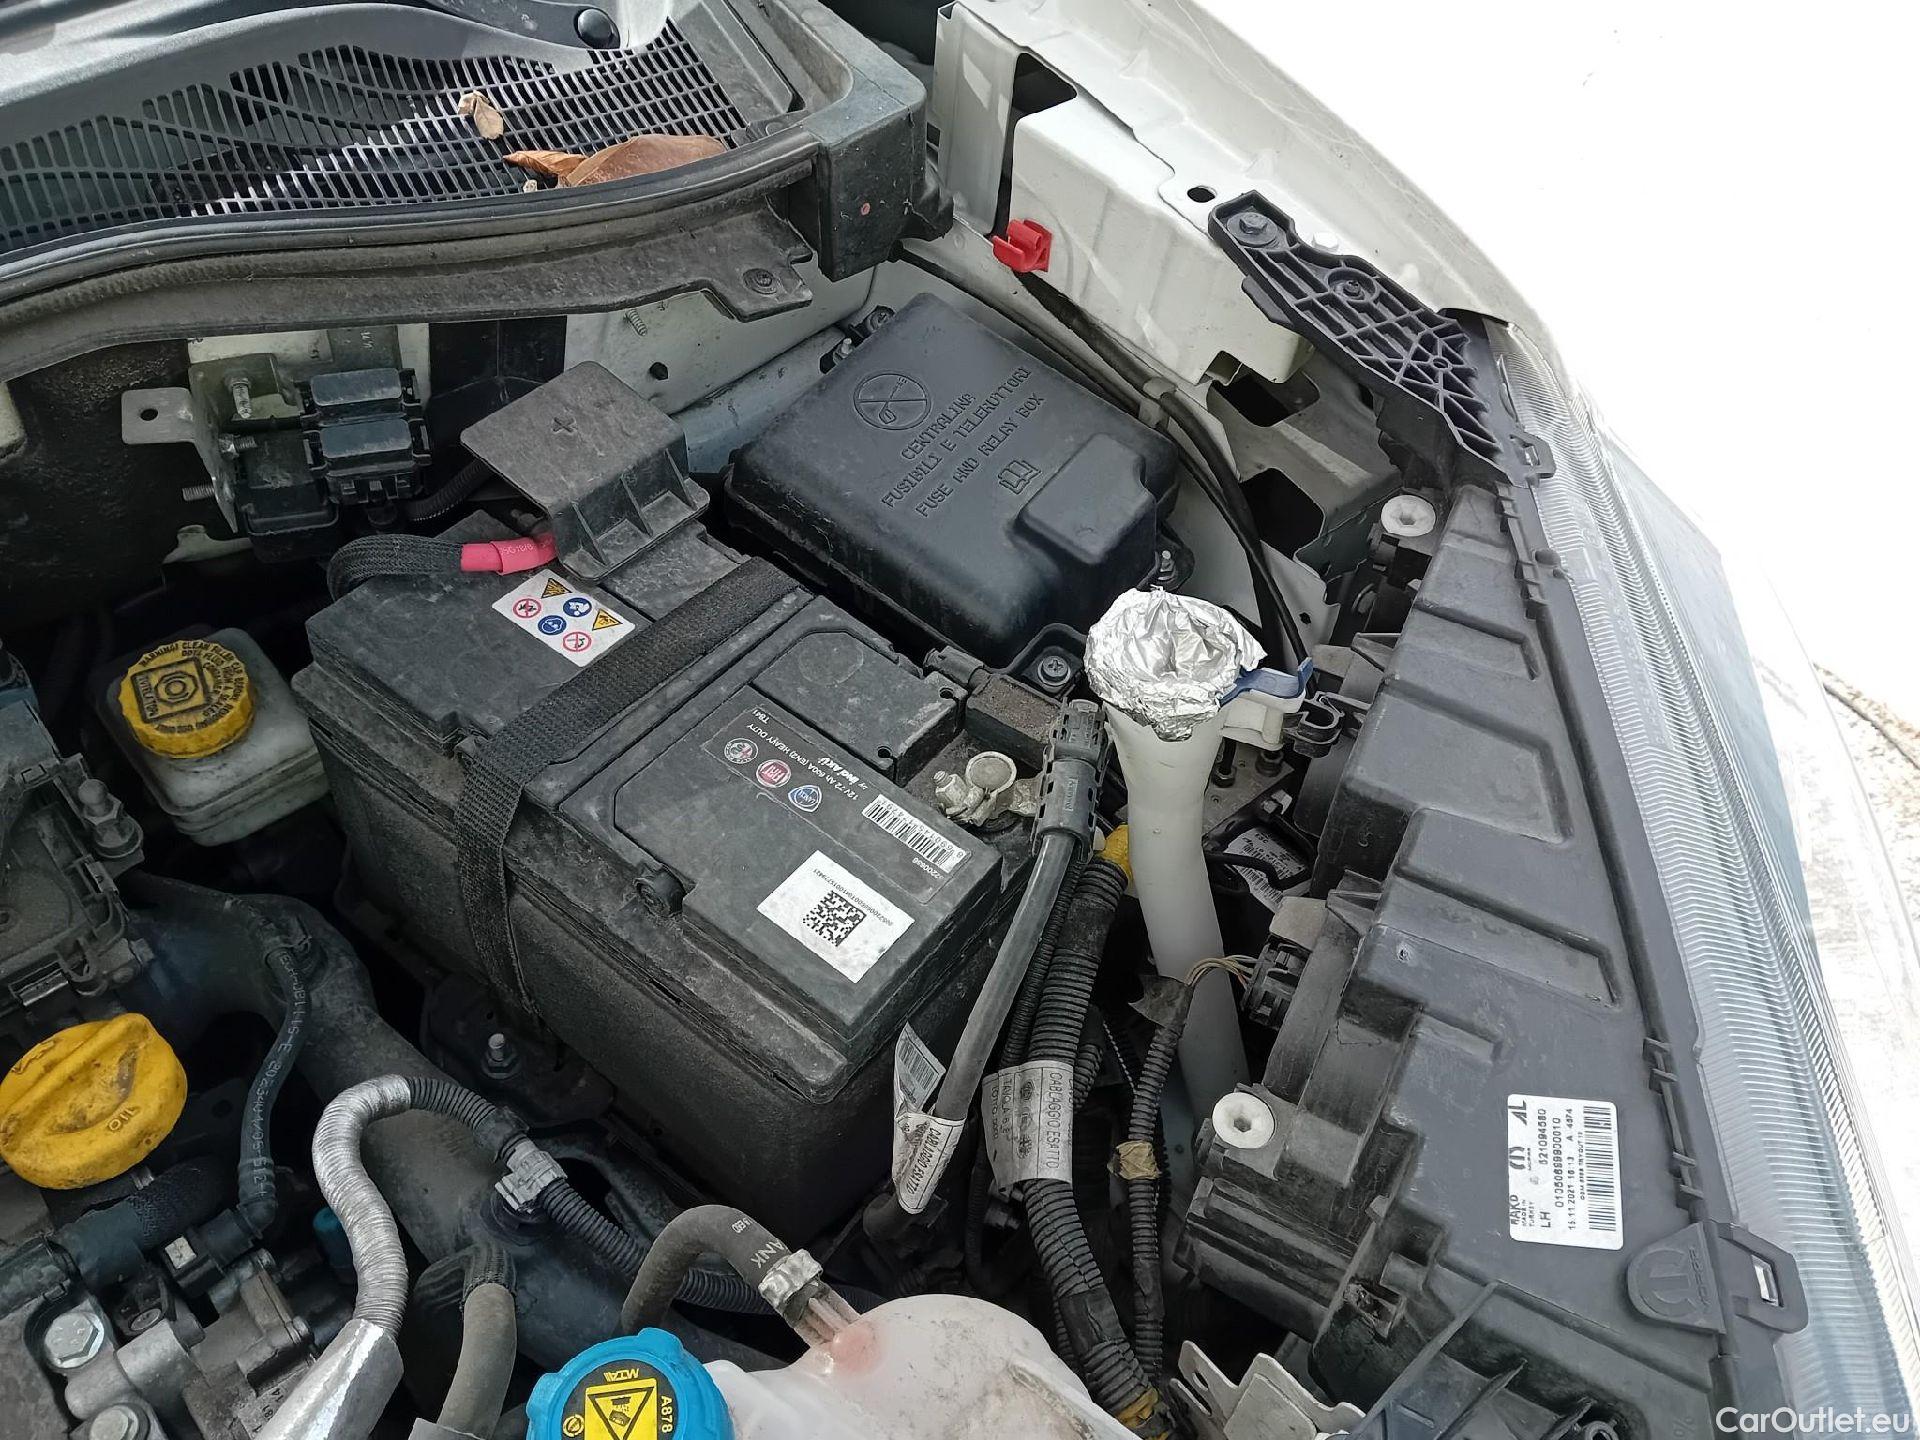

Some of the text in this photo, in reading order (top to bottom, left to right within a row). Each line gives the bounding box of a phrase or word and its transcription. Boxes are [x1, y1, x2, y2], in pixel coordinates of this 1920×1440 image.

[881, 367, 1031, 507] FUSIBILI E TELERUTTORI
[901, 393, 976, 460] CENTRALINA
[915, 393, 1044, 517] FUSE AND RELAY BOX
[182, 641, 210, 650] CLEAN
[746, 723, 768, 739] DUTY
[766, 736, 790, 755] HEAVY
[108, 1107, 141, 1132] OIL
[1046, 1072, 1063, 1169] CABLAGGIO ESATTO
[1540, 1211, 1551, 1228] LH
[659, 1394, 673, 1433] A878
